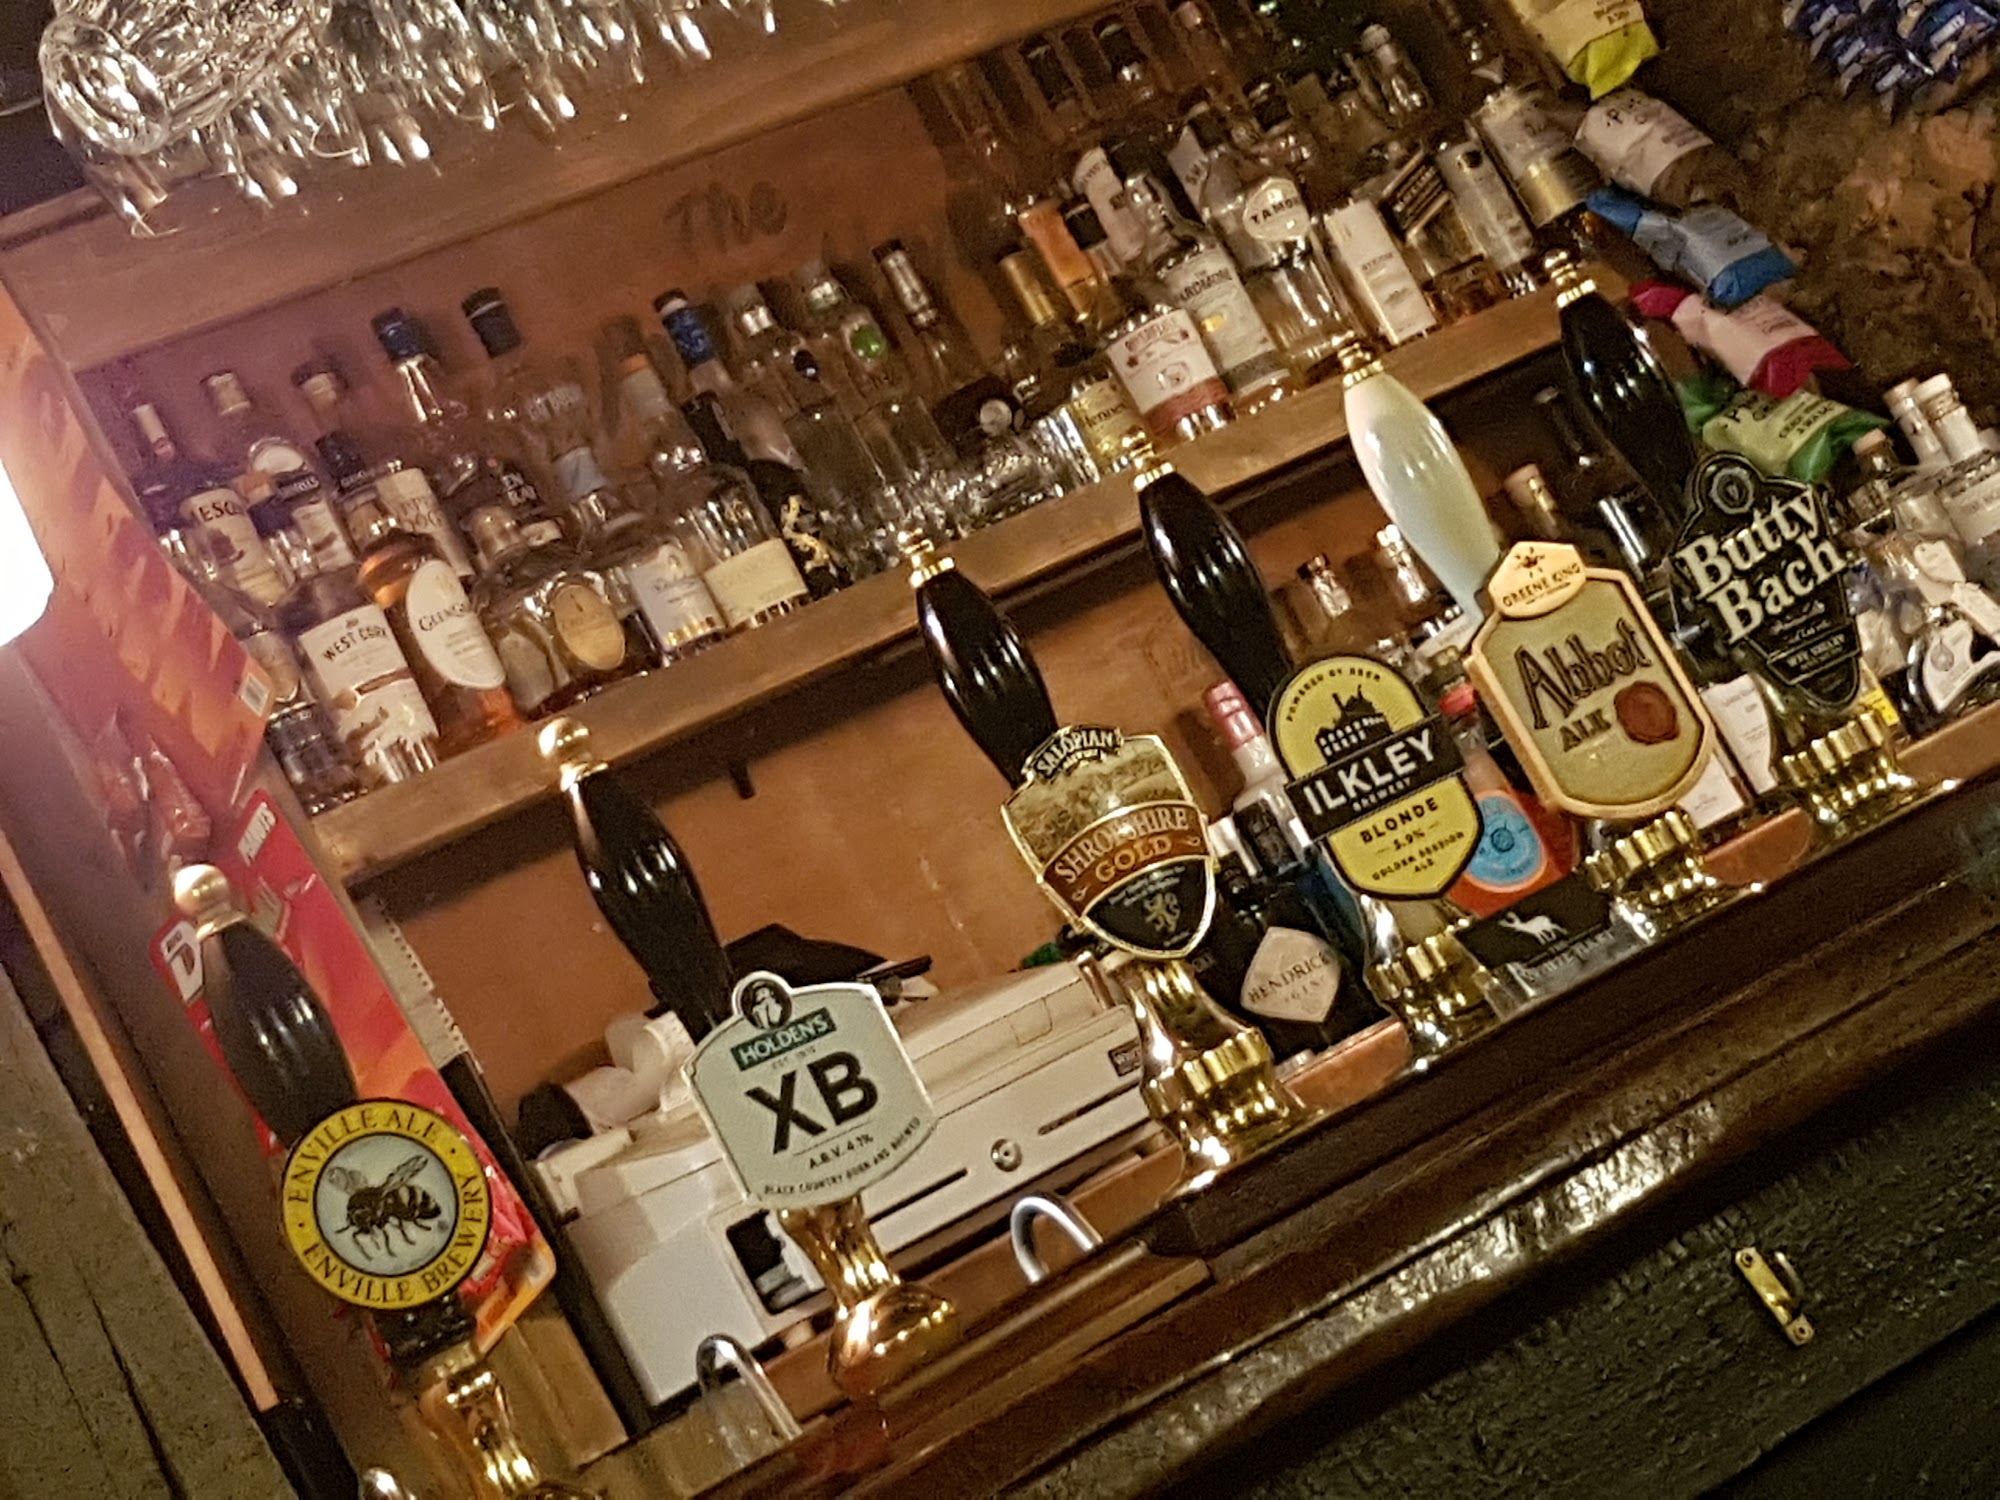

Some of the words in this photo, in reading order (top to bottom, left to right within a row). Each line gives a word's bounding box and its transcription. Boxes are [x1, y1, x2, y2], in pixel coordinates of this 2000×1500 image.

[1674, 484, 1819, 600] Butty
[1502, 579, 1550, 608] GREENE
[1552, 562, 1582, 584] KING
[1706, 531, 1848, 646] Bach
[322, 631, 357, 662] WEST
[1514, 616, 1653, 730] Abbot
[1036, 729, 1115, 776] SALOPIAN
[1559, 708, 1612, 752] ALE
[1303, 728, 1434, 816] ILKLEY
[1054, 806, 1190, 884] SHROPSHIRE
[1095, 836, 1172, 882] GOLD
[1359, 797, 1439, 844] BLONDE
[744, 1051, 879, 1155] XB
[288, 1107, 378, 1204] ENVILLE
[384, 1109, 443, 1145] ALE
[798, 1173, 845, 1193] COUNTRY
[872, 1149, 891, 1166] AND
[302, 1242, 417, 1304] ENVILLE
[420, 1172, 485, 1294] BREWERY
